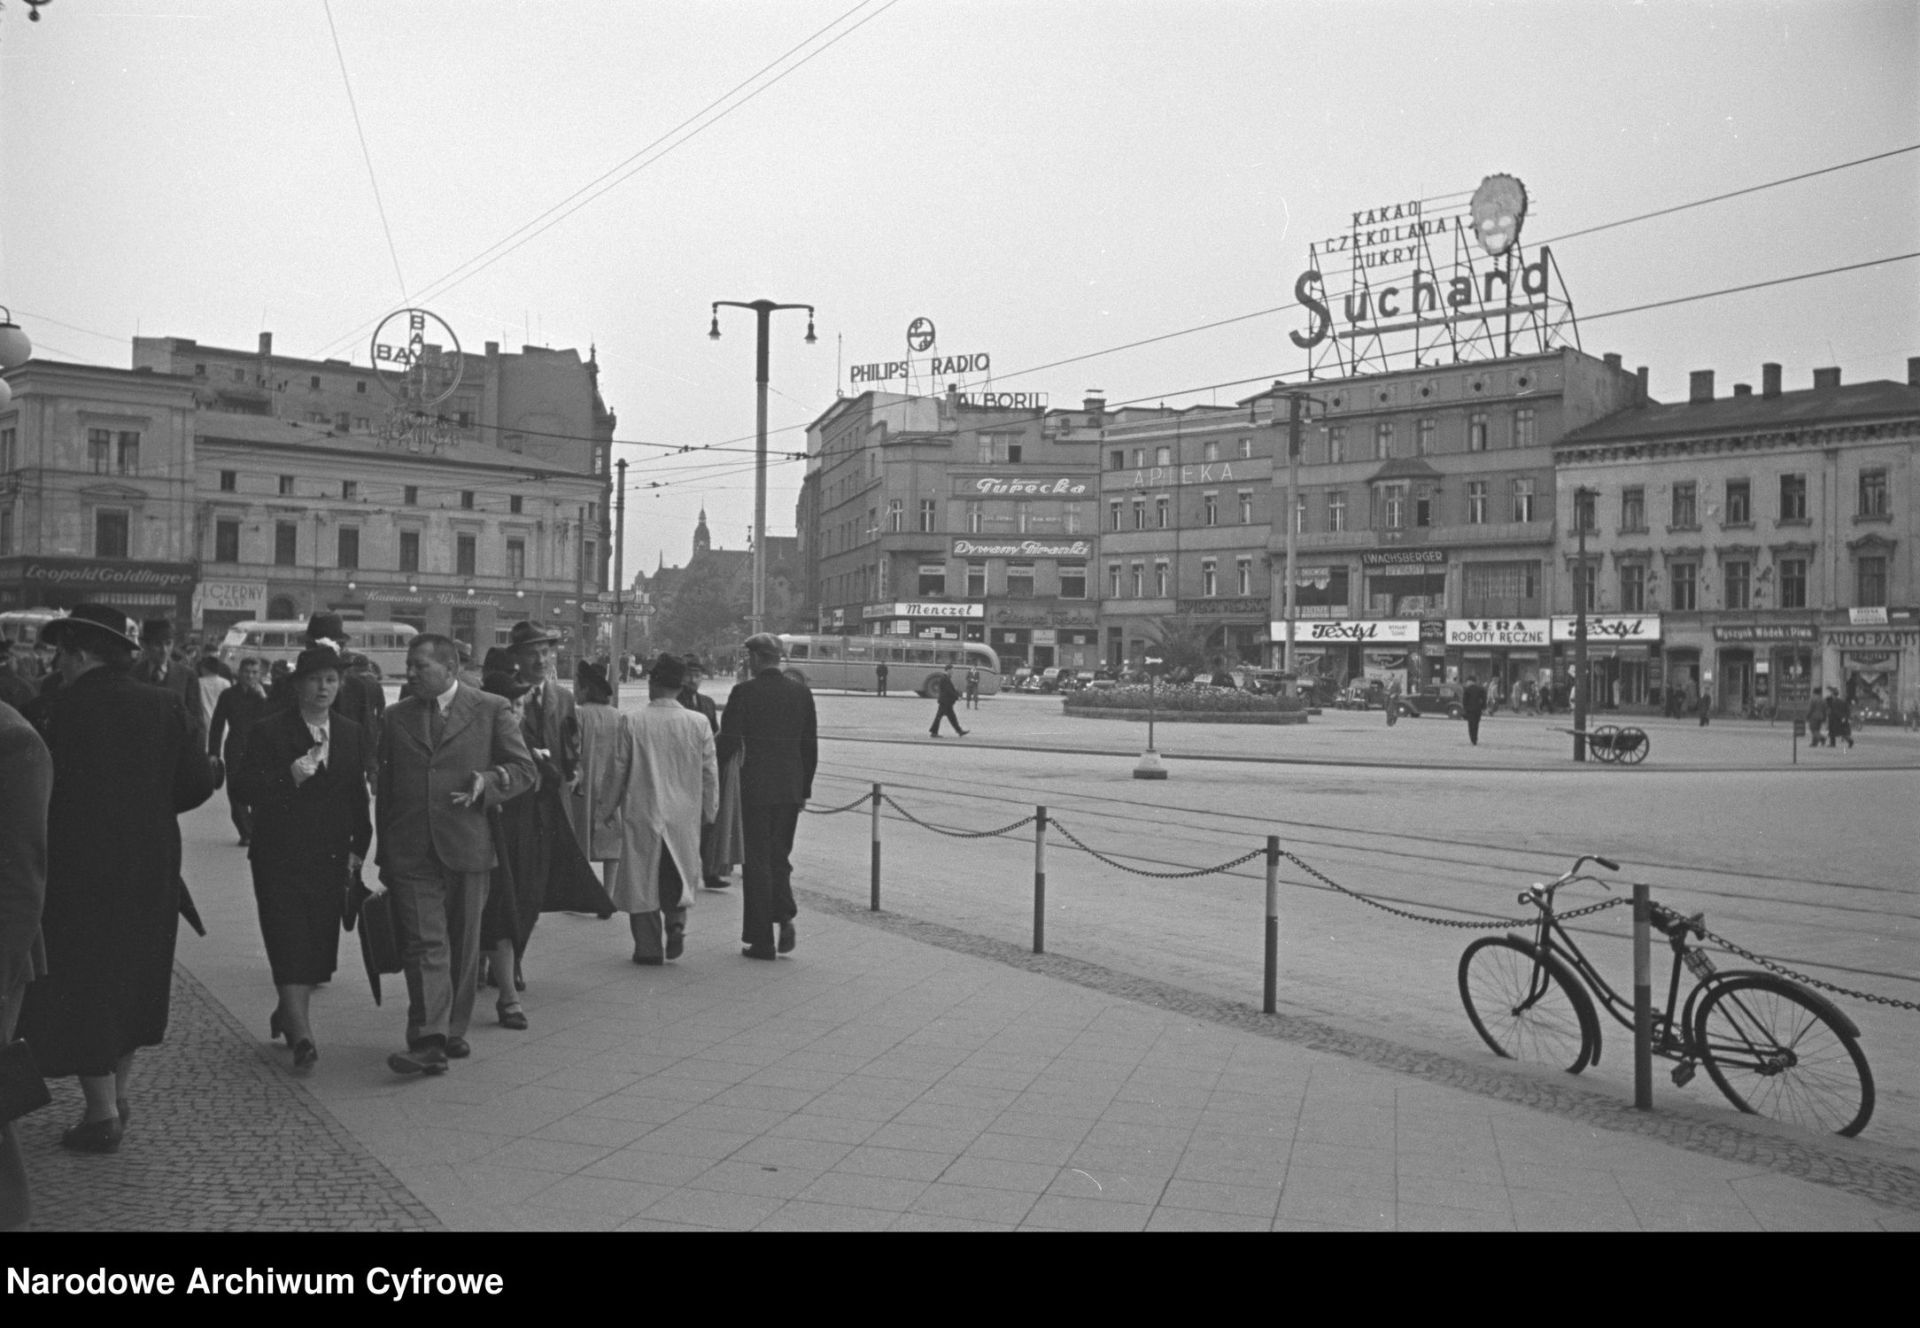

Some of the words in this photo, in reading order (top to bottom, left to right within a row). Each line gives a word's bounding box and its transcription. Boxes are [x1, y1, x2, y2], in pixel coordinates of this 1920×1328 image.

[1353, 201, 1420, 227] KAKAO
[1325, 218, 1447, 254] CZEKOLADA
[1353, 245, 1420, 270] CUKRY
[1289, 246, 1549, 349] Suchard
[851, 361, 909, 383] PHILIPS
[932, 353, 990, 376] RADIO
[976, 478, 1086, 494] Turecka
[954, 541, 1020, 556] Dywany
[25, 564, 98, 583] Leopold
[99, 567, 192, 587] Goldfinger
[210, 584, 265, 600] CZERNY
[906, 603, 973, 616] Menczel
[1311, 621, 1379, 641] Textyl
[1468, 621, 1526, 631] VERA
[1452, 631, 1495, 643] ROBOTY
[1499, 631, 1544, 644] RĘCZNE
